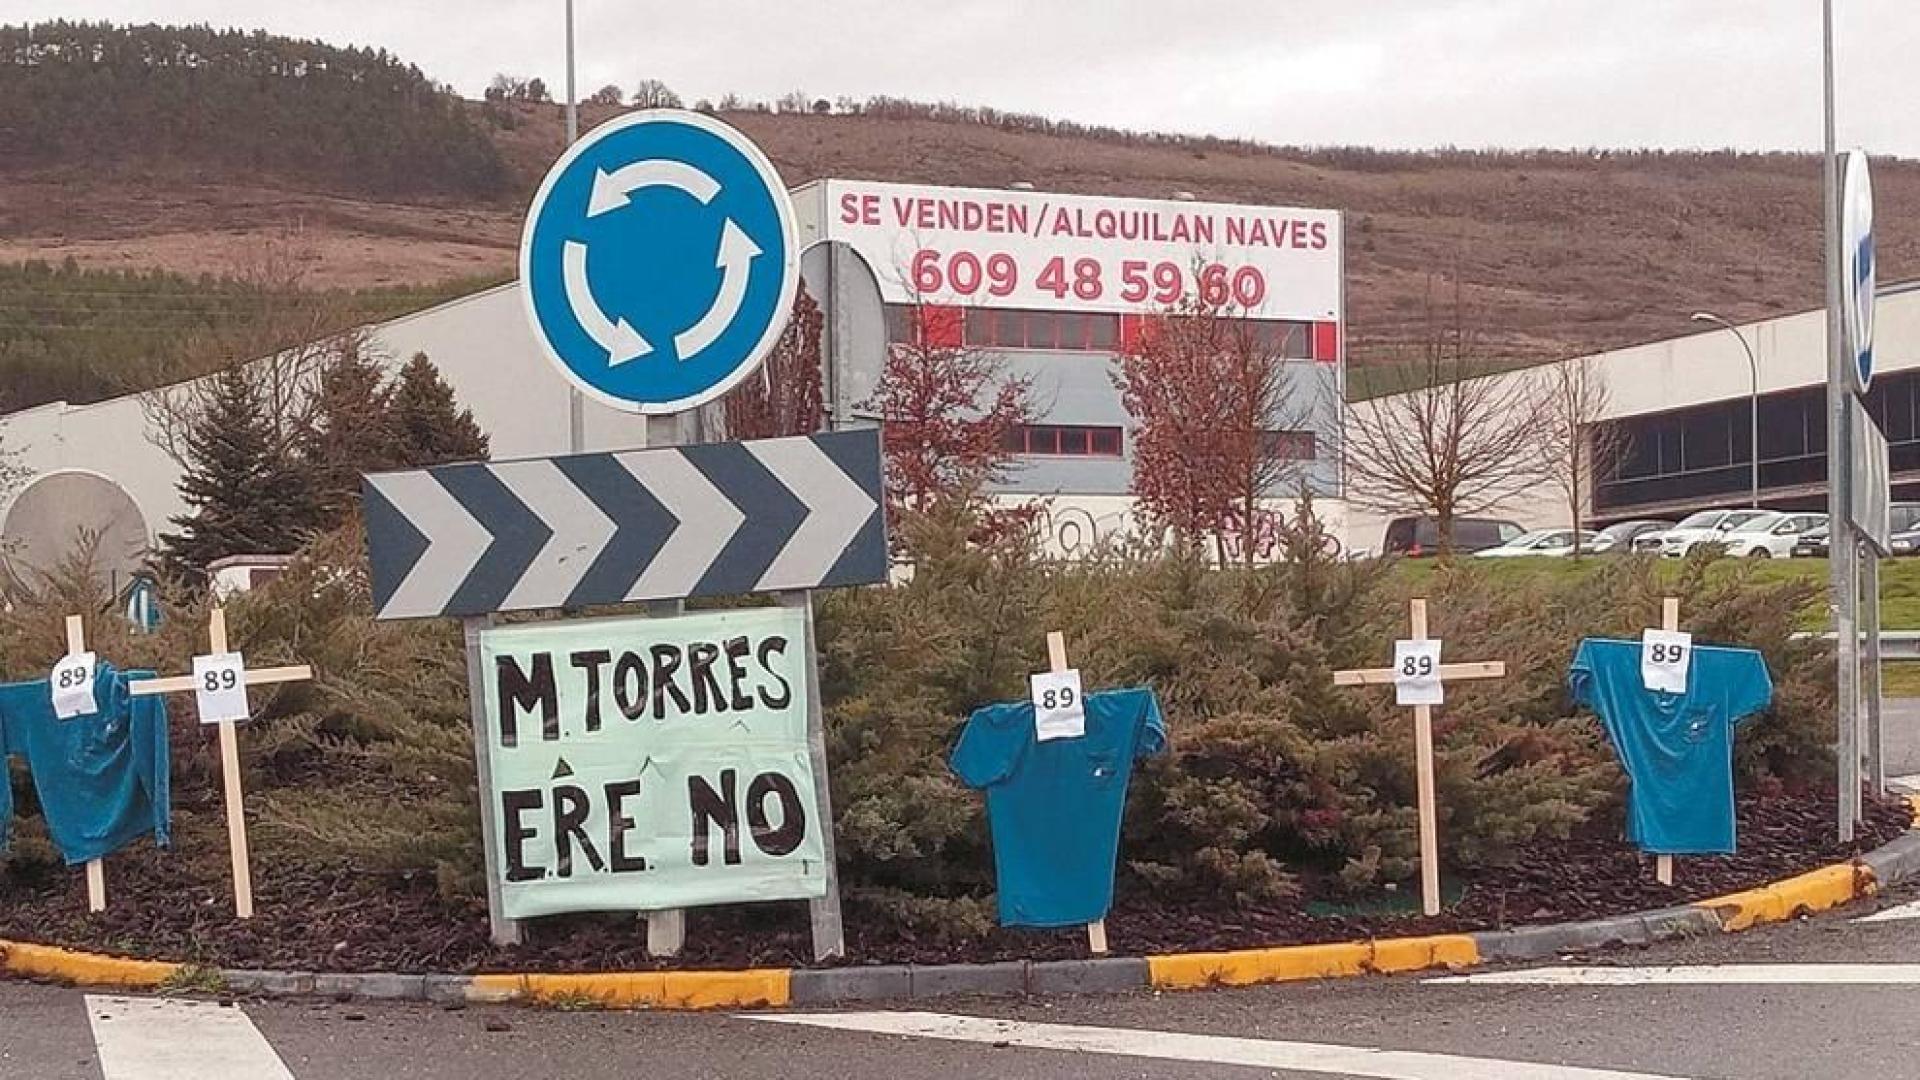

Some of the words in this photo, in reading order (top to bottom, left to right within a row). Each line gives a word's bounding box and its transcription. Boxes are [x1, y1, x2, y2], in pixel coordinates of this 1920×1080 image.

[840, 193, 881, 226] SE
[1226, 216, 1328, 250] NAVES
[911, 248, 1019, 297] 609
[1035, 256, 1104, 300] 48
[1121, 260, 1183, 304] 59
[1199, 263, 1266, 308] 60
[1650, 642, 1684, 664] 89
[58, 666, 86, 688] 89
[1402, 654, 1432, 677] 89
[204, 668, 237, 692] 89
[1042, 687, 1075, 710] 89
[688, 768, 806, 866] NO
